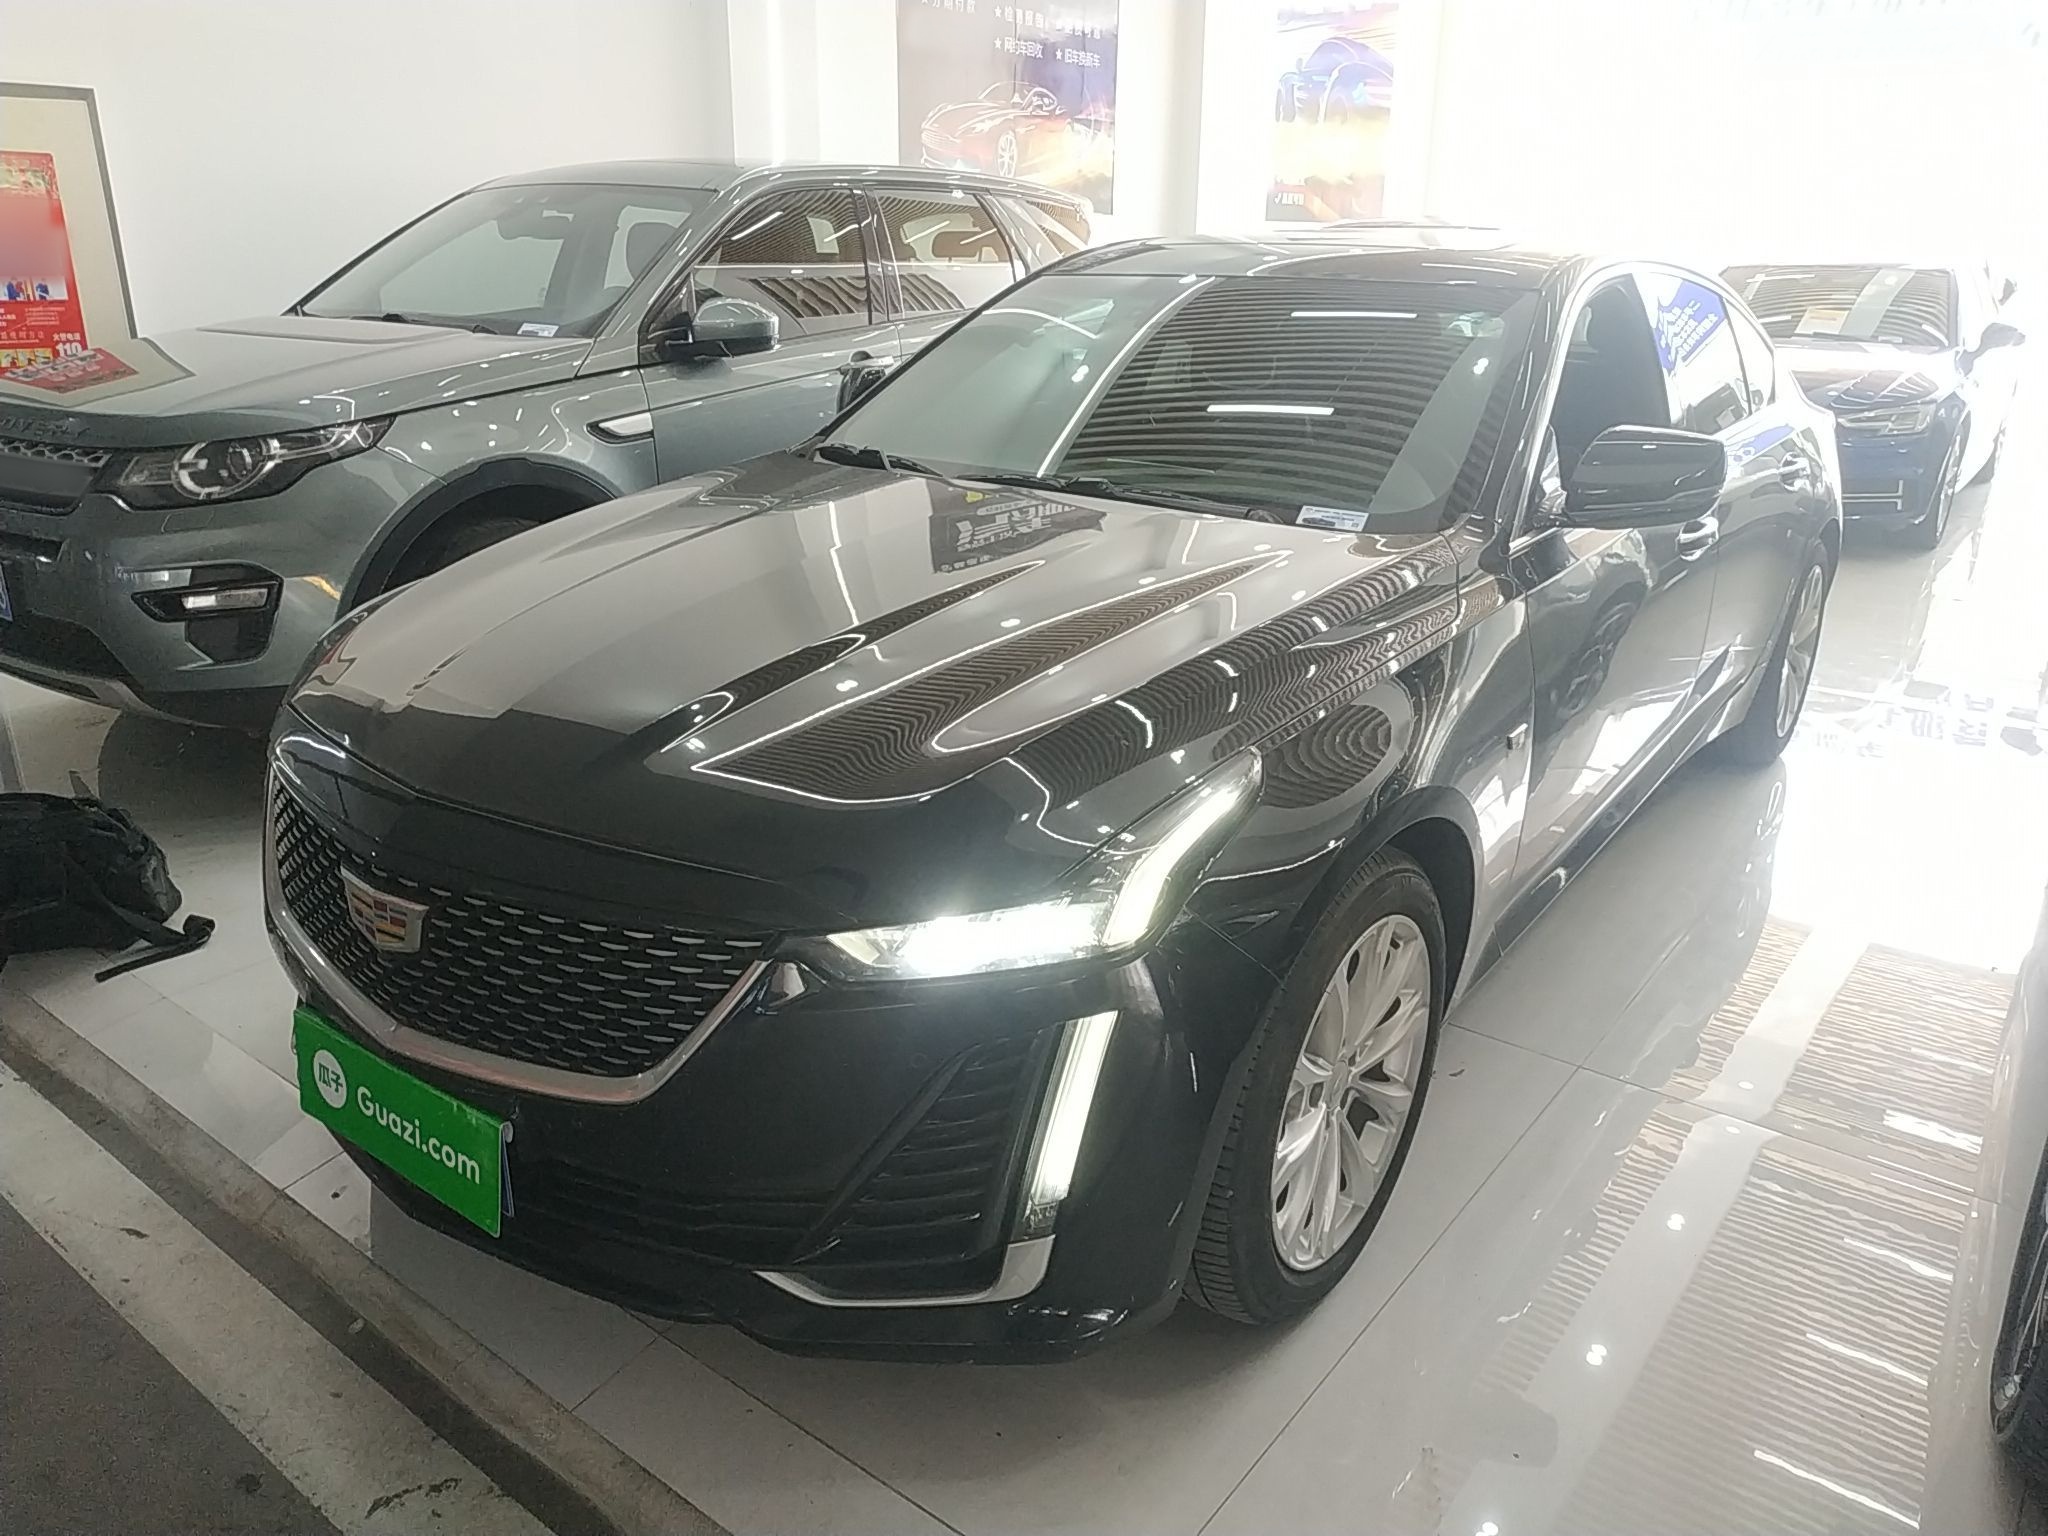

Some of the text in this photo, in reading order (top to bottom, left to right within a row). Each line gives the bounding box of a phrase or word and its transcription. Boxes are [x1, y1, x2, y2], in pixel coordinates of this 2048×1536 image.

[1004, 37, 1043, 59] 网约车回收
[1064, 48, 1101, 69] 旧车换新车
[318, 1062, 344, 1093] 瓜子
[357, 1086, 481, 1185] Guazi.com
